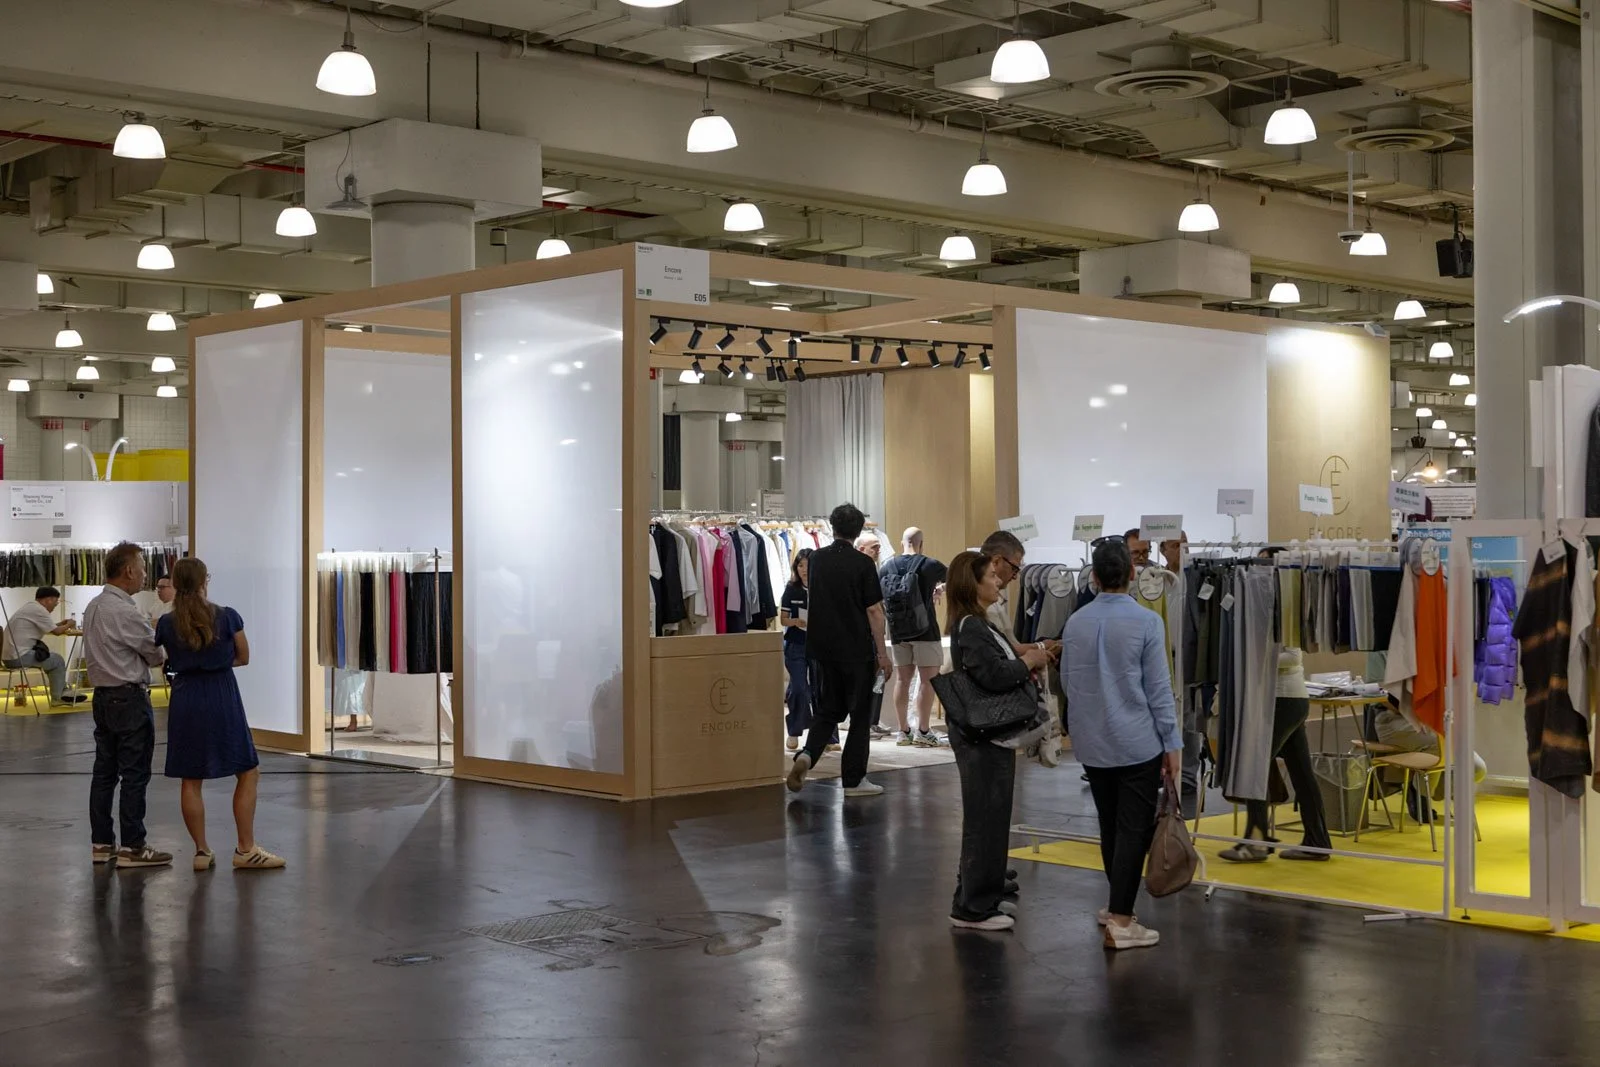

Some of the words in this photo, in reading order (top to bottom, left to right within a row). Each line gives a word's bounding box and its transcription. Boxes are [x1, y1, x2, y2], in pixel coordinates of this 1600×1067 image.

[664, 265, 682, 274] Encore
[694, 293, 707, 303] E05
[1404, 529, 1451, 540] ghtweight
[701, 720, 747, 733] ENCORE
